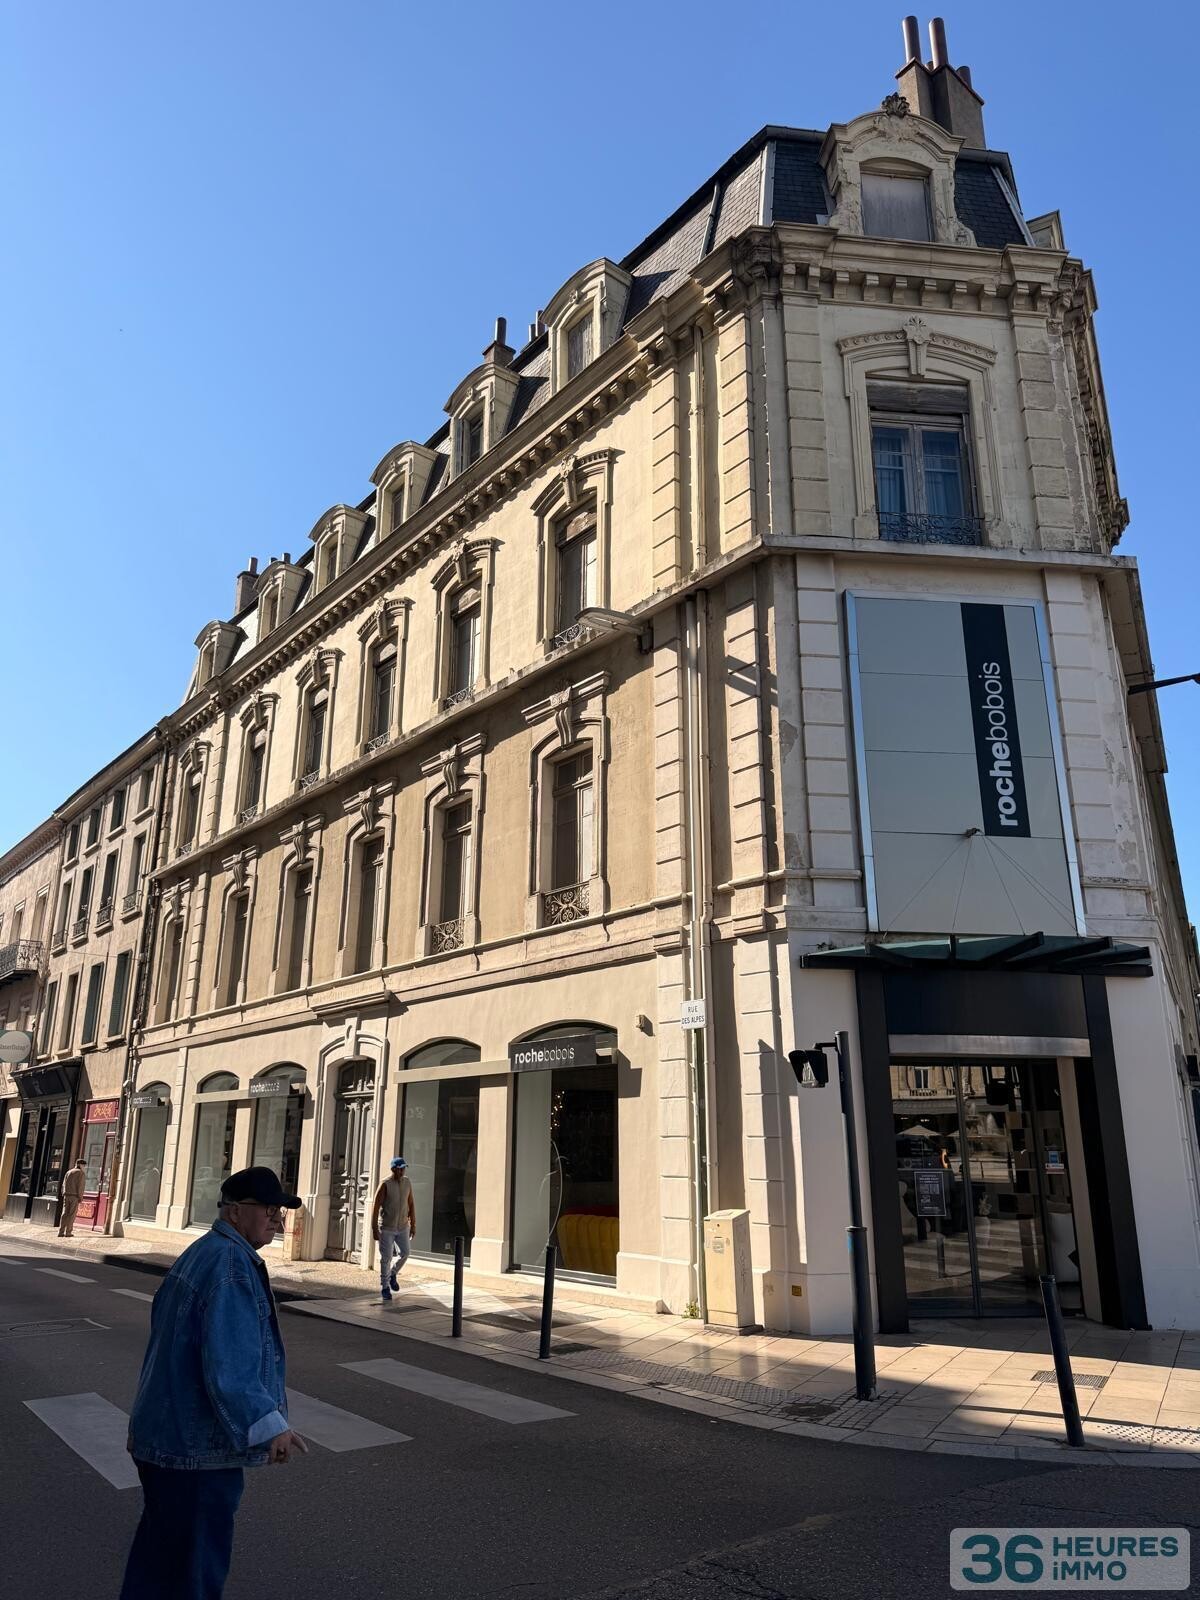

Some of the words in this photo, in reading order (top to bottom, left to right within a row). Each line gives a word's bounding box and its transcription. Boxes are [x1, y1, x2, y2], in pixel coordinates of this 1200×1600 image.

[978, 661, 1018, 827] rochebobois
[687, 1005, 698, 1013] RUE
[681, 1017, 690, 1025] DES
[691, 1015, 705, 1023] ALPES
[514, 1044, 575, 1064] rochebobois
